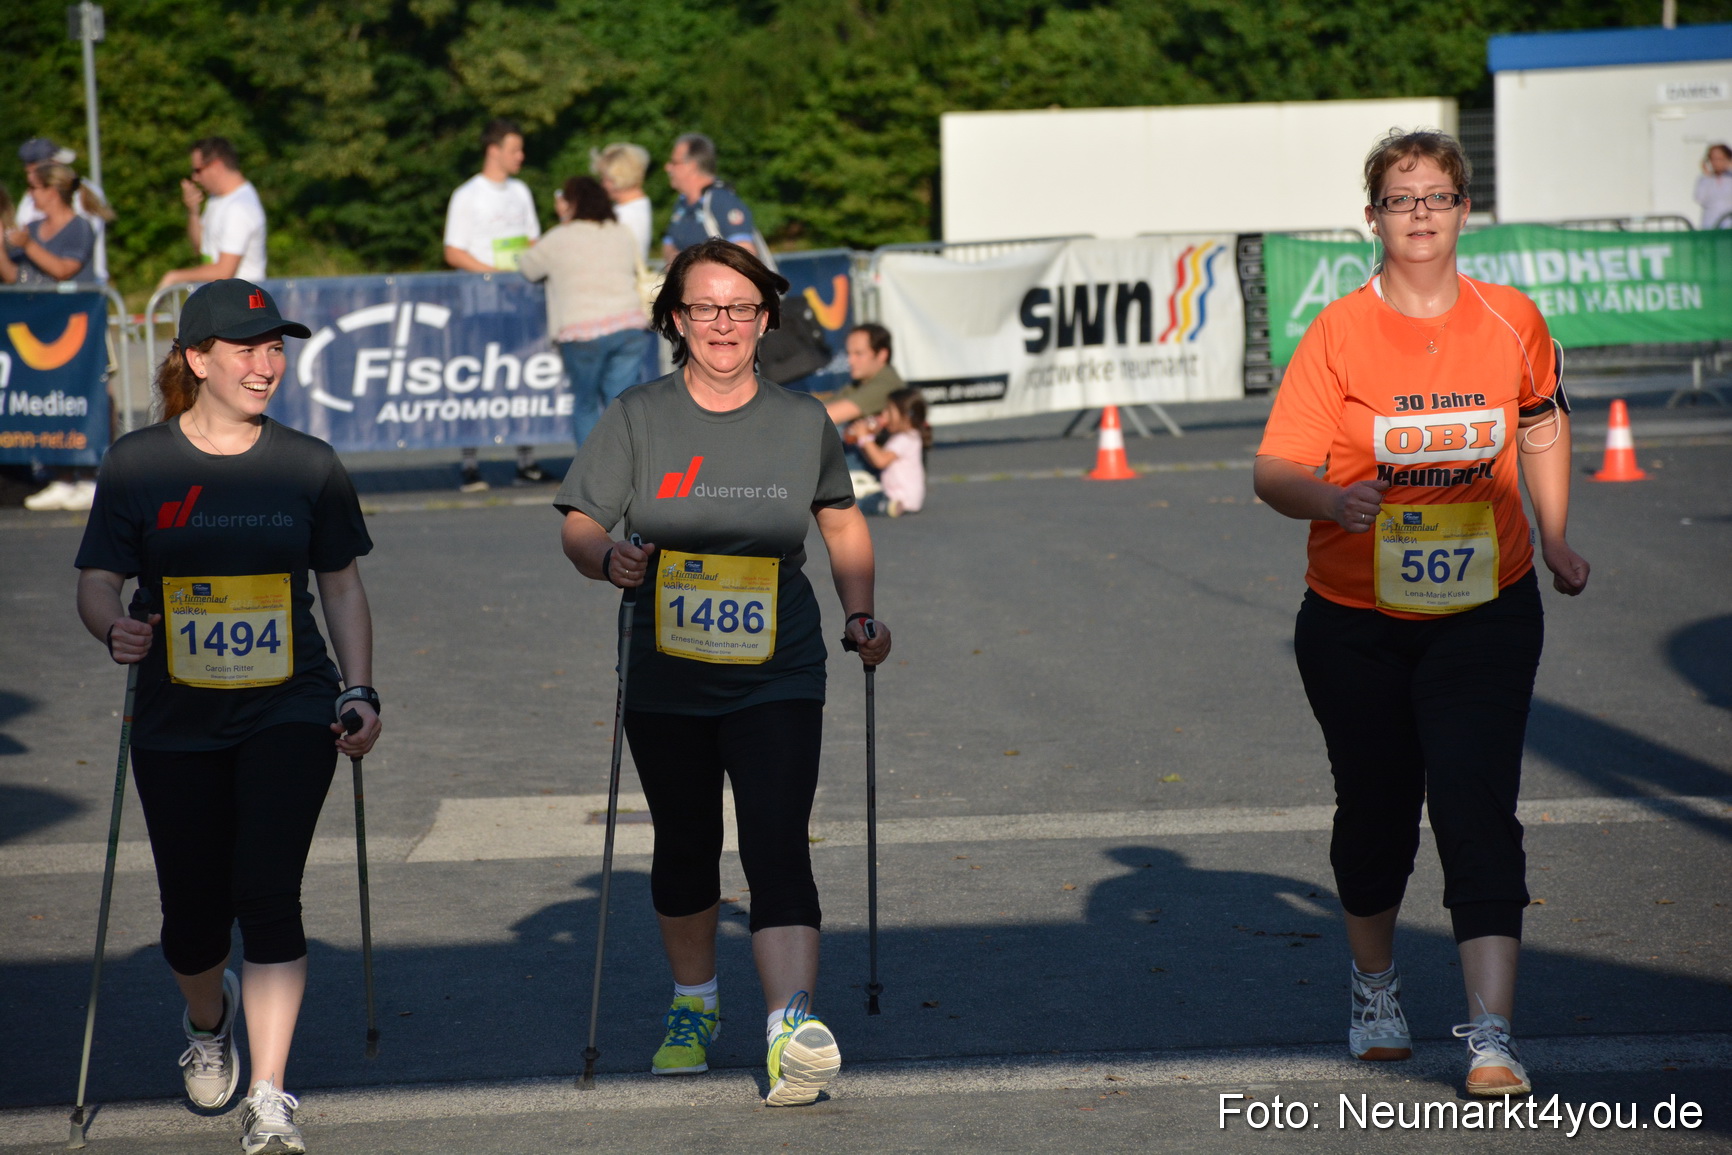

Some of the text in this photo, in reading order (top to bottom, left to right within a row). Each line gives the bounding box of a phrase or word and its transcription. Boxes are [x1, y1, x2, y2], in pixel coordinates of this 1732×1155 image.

[1020, 280, 1153, 354] swn
[352, 341, 570, 397] Fische
[9, 390, 88, 417] Medien
[376, 394, 576, 424] AUTOMOBILE
[1394, 392, 1486, 412] 30 Jahre
[1384, 420, 1498, 455] OBI
[694, 482, 788, 499] duerrer.de
[191, 511, 294, 528] duerrer.de
[676, 570, 719, 581] firmenlauf
[1400, 547, 1475, 584] 567
[184, 595, 228, 604] firmenlauf
[1404, 590, 1471, 599] Lena-Marie Kuske
[669, 595, 765, 634] 1486
[180, 619, 281, 657] 1494
[670, 634, 759, 649] Ernestine Altenthan-Auer
[205, 664, 254, 673] Carolin Ritter
